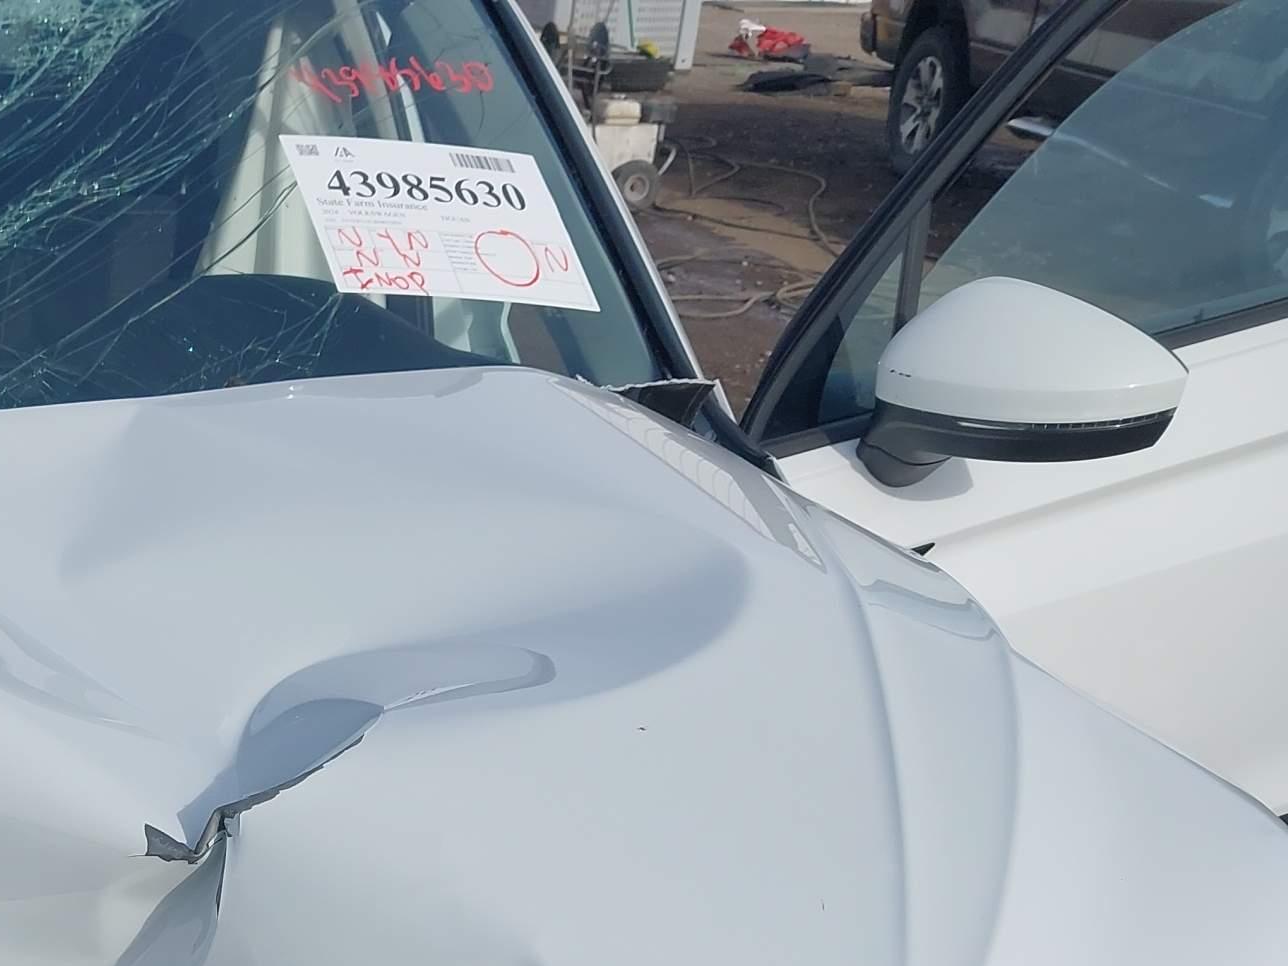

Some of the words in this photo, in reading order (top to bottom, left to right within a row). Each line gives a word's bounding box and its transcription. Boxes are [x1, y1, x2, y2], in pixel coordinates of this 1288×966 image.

[327, 170, 526, 211] 43985630
[317, 198, 344, 206] State
[344, 199, 375, 208] Farm
[377, 201, 429, 211] Insurance
